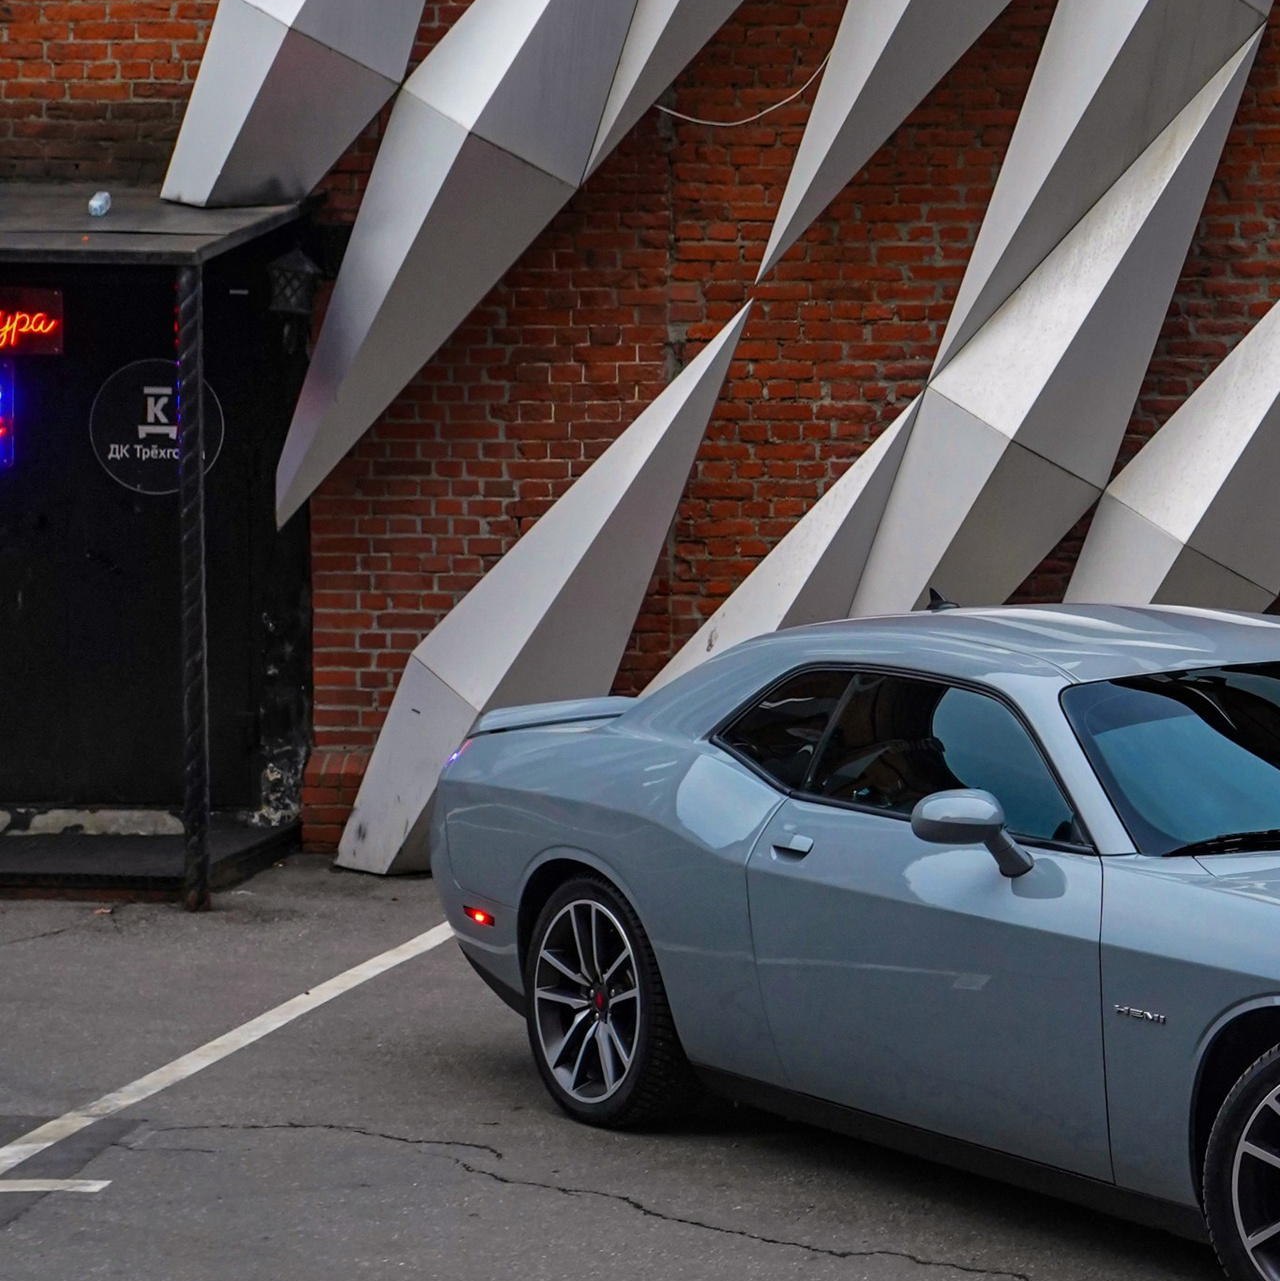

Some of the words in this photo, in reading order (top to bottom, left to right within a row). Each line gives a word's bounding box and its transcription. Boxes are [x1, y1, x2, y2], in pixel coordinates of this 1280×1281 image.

[108, 443, 130, 460] ДК
[133, 444, 205, 461] Трёхго
[1114, 1004, 1166, 1023] HEMI
